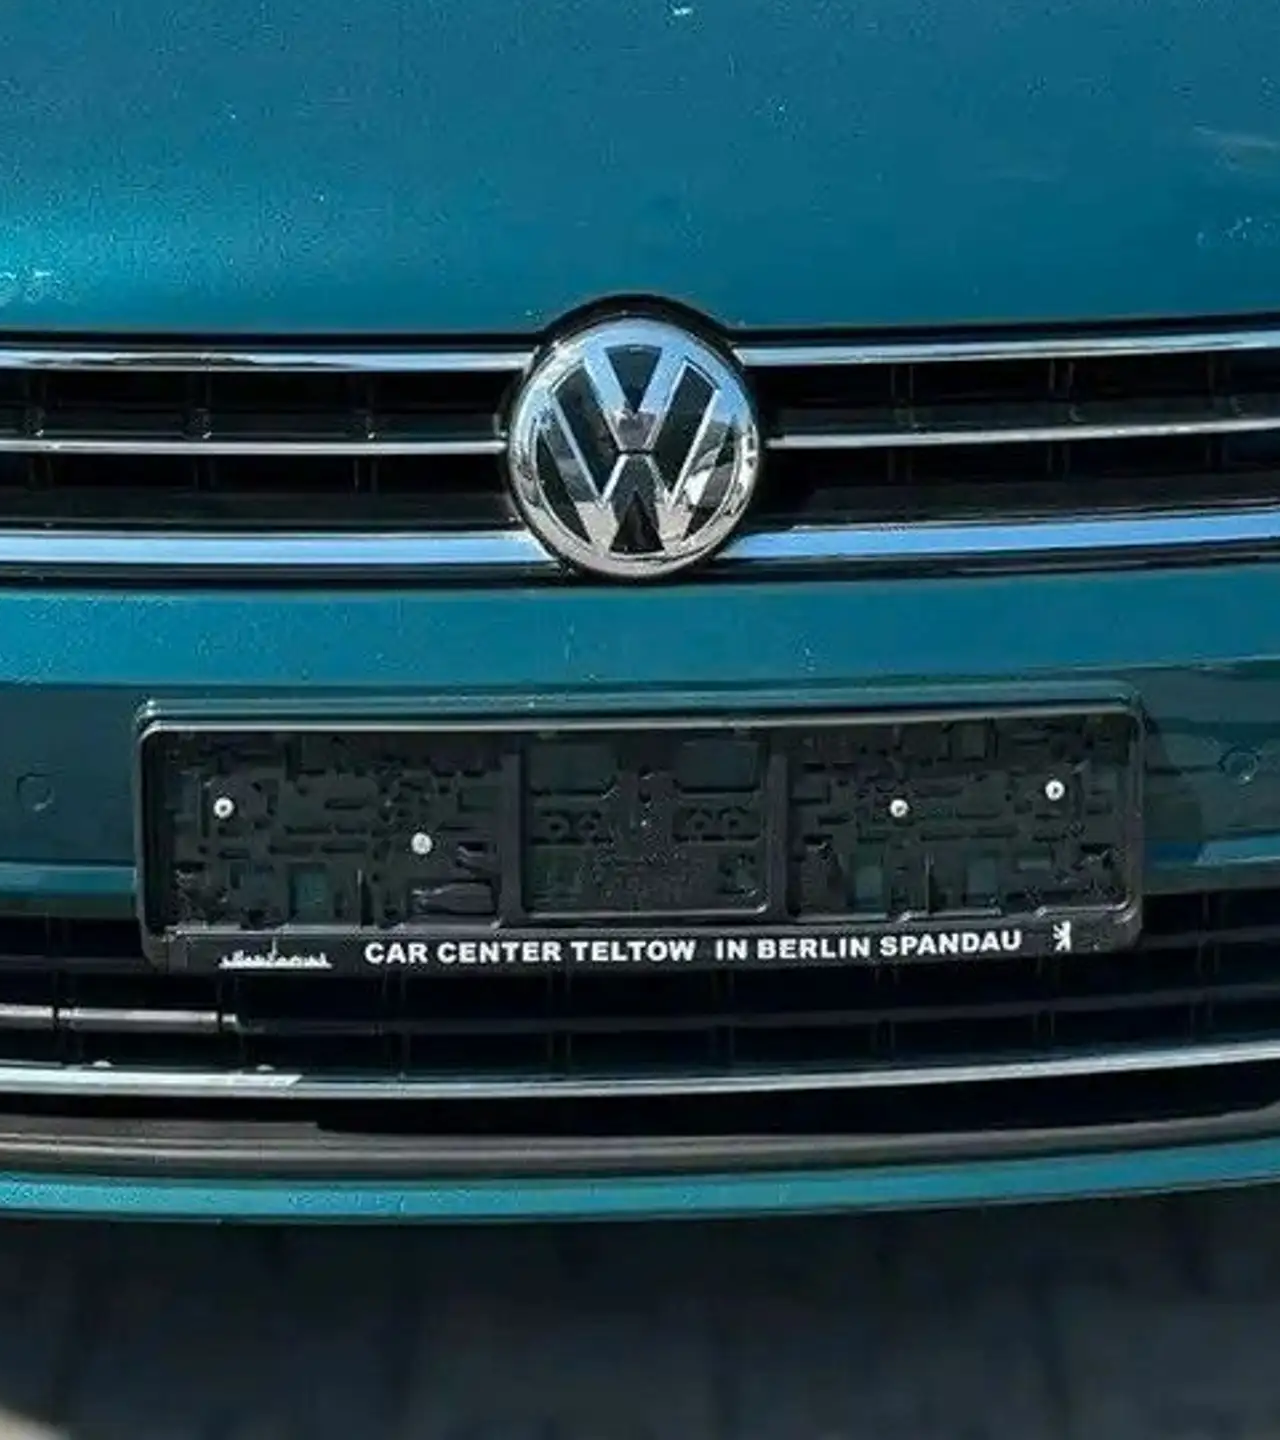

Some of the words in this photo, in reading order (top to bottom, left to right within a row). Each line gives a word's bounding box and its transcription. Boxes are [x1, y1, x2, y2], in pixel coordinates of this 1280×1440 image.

[364, 942, 428, 964] CAR
[437, 941, 562, 964] CENTER
[571, 940, 695, 962] TELTOW
[716, 939, 748, 960] IN
[757, 937, 871, 959] BERLIN
[879, 930, 1022, 957] SPANDAU
